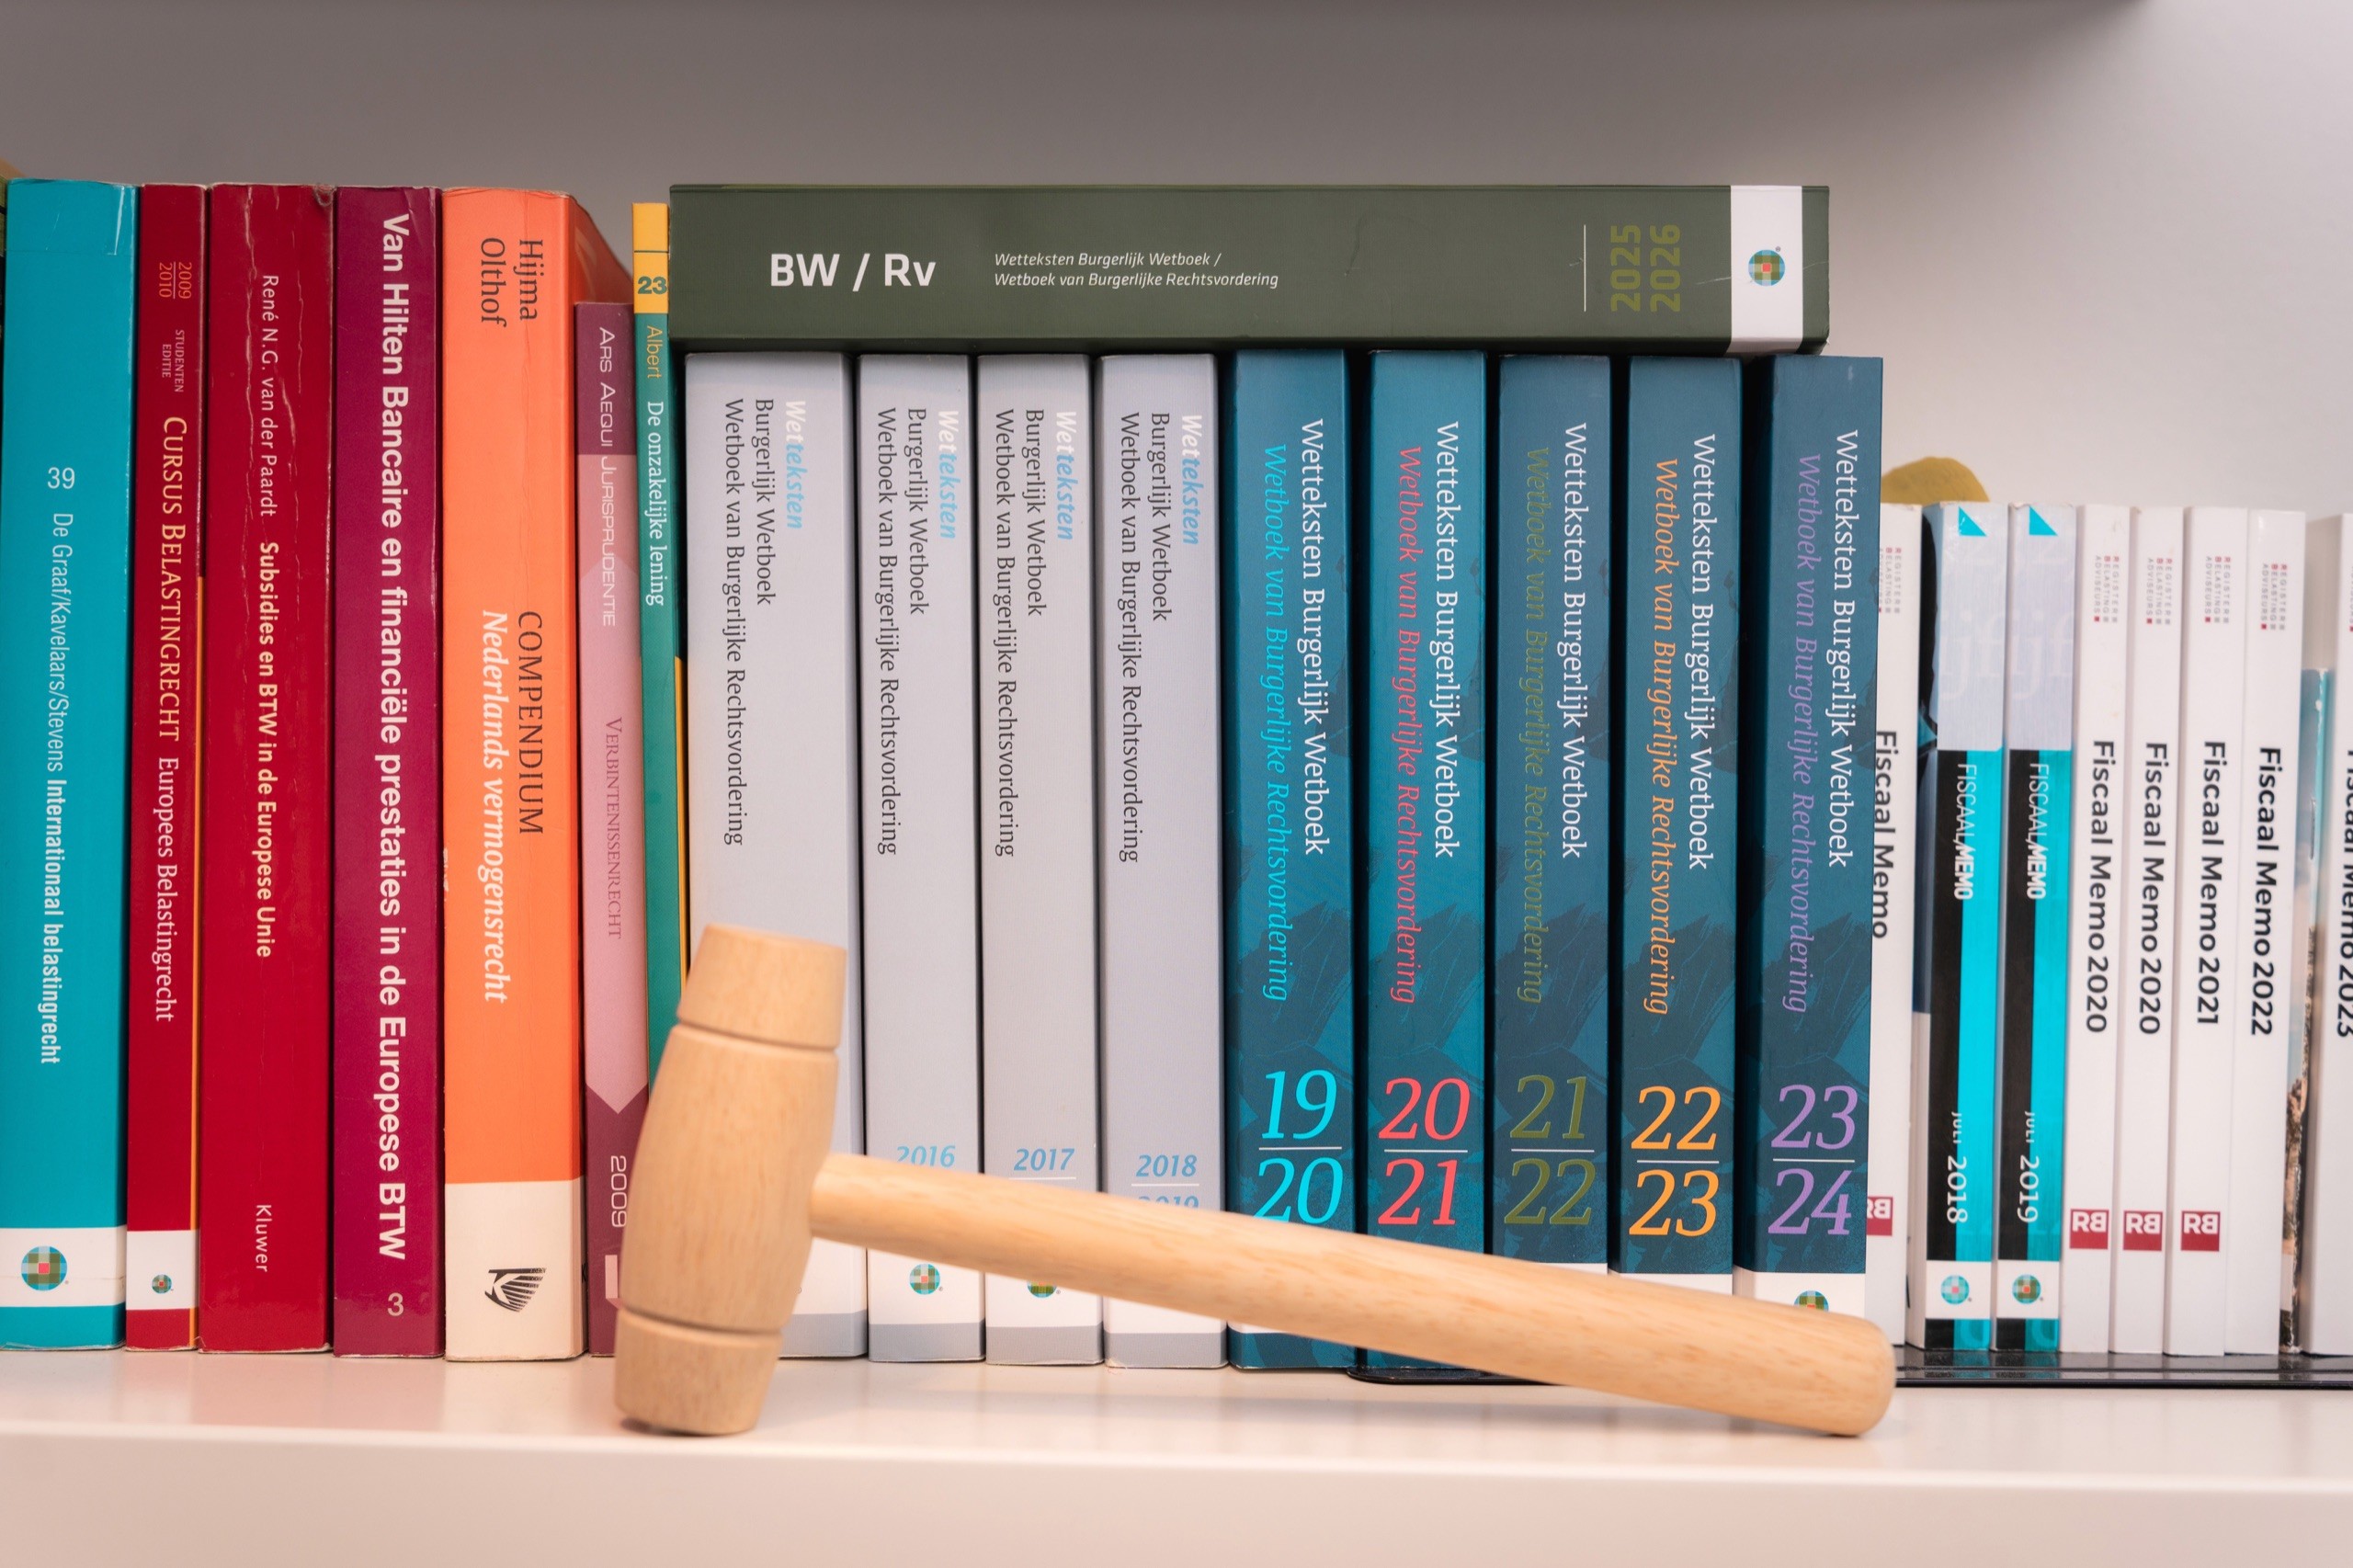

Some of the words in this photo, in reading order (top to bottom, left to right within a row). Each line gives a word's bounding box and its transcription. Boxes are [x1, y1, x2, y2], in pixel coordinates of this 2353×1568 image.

[159, 262, 173, 298] 2010
[178, 262, 191, 299] 2009
[383, 214, 410, 272] Van
[481, 238, 506, 327] Olthof
[513, 240, 543, 321] Hijma
[638, 277, 667, 295] 23
[770, 253, 840, 287] BW
[884, 254, 936, 286] Rv
[995, 253, 1074, 267] Wetteksten
[1078, 253, 1144, 270] Burgerlijk
[1149, 253, 1211, 267] Wetboek
[995, 273, 1055, 287] Wetboek
[1059, 276, 1086, 286] van
[1088, 273, 1162, 290] Burgerlijke
[1165, 273, 1279, 290] Rechtsvordering
[1610, 224, 1642, 312] 2025
[1650, 224, 1680, 312] 2026
[263, 276, 278, 321] René
[382, 283, 410, 374] Hilten
[163, 344, 171, 378] EDITIE
[175, 330, 184, 392] STUDENTEN
[261, 328, 278, 369] N.G.
[261, 377, 273, 411] van
[599, 327, 615, 373] ARS
[647, 325, 663, 379] Albert
[261, 417, 278, 449] der
[381, 387, 409, 528] Bancaire
[600, 382, 616, 447] AEQUI
[647, 402, 664, 426] De
[724, 399, 745, 494] Wetboek
[751, 399, 776, 502] Burgerlijk
[877, 408, 899, 504] Wetboek
[995, 409, 1017, 505] Wetboek
[1022, 408, 1046, 513] Burgerlijk
[1120, 412, 1142, 509] Wetboek
[48, 468, 74, 489] 39
[164, 417, 187, 514] CURSUS
[260, 455, 278, 517] Paardt
[644, 431, 667, 540] onzakelijke
[786, 401, 807, 529] Wetteksten
[938, 410, 961, 540] Wetteksten
[1056, 411, 1077, 540] Wetteksten
[1147, 412, 1171, 517] Burgerlijk
[1181, 415, 1205, 545] Wetteksten
[1264, 444, 1287, 562] Wetboek
[1301, 418, 1324, 578] Wetteksten
[1399, 447, 1422, 562] Wetboek
[1436, 421, 1460, 582] Wetteksten
[1564, 422, 1589, 582] Wetteksten
[1835, 430, 1859, 590] Wetteksten
[53, 514, 73, 537] De
[381, 539, 402, 576] en
[601, 456, 616, 626] JURISPRUDENTIE
[726, 501, 741, 539] van
[756, 510, 776, 606] Wetboek
[879, 511, 893, 548] van
[996, 512, 1011, 549] van
[1121, 517, 1136, 553] van
[1654, 459, 1679, 575] Wetboek
[1691, 434, 1716, 593] Wetteksten
[259, 543, 279, 644] Subsidies
[645, 545, 667, 607] lening
[722, 546, 745, 663] Burgerlijke
[875, 554, 899, 672] Burgerlijke
[908, 519, 930, 616] Wetboek
[994, 556, 1017, 674] Burgerlijke
[1026, 520, 1048, 617] Wetboek
[1151, 525, 1172, 622] Wetboek
[1266, 571, 1285, 617] van
[1399, 573, 1419, 619] van
[1654, 585, 1674, 631] van
[48, 546, 73, 771] Graaf/Kavelaars/Stevens
[159, 525, 186, 741] BELASTINGRECHT
[259, 652, 274, 676] en
[381, 586, 408, 744] financiële
[1118, 561, 1142, 678] Burgerlijke
[1298, 588, 1330, 724] Burgerlijk
[1430, 591, 1461, 727] Burgerlijk
[1558, 593, 1589, 727] Burgerlijk
[258, 684, 278, 736] BTW
[483, 610, 509, 769] Nederlands
[1260, 627, 1291, 773] Burgerlijke
[1392, 629, 1422, 774] Burgerlijke
[1647, 641, 1677, 788] Burgerlijke
[1686, 604, 1714, 739] Burgerlijk
[1827, 601, 1858, 736] Burgerlijk
[258, 744, 278, 762] in
[518, 611, 543, 835] COMPENDIUM
[724, 669, 747, 846] Rechtsvordering
[878, 678, 902, 856] Rechtsvordering
[995, 680, 1018, 857] Rechtsvordering
[153, 758, 178, 857] Europees
[257, 768, 278, 794] de
[1120, 686, 1143, 862] Rechtsvordering
[1303, 733, 1331, 855] Wetboek
[1434, 736, 1461, 858] Wetboek
[1561, 736, 1587, 858] Wetboek
[1687, 747, 1714, 869] Wetboek
[1828, 745, 1855, 868] Wetboek
[1874, 731, 1896, 833] Fiscaal
[2091, 741, 2115, 845] Fiscaal
[2143, 743, 2167, 846] Fiscaal
[2201, 741, 2225, 845] Fiscaal
[2257, 747, 2281, 851] Fiscaal
[44, 779, 66, 915] Internationaal
[252, 801, 277, 900] Europese
[374, 754, 406, 916] prestaties
[606, 717, 622, 939] VERBINTENISSENRECHT
[256, 907, 276, 957] Unie
[477, 778, 511, 1003] vermogensrecht
[1262, 781, 1293, 1002] Rechtsvordering
[1392, 784, 1422, 1005] Rechtsvordering
[1643, 796, 1676, 1015] Rechtsvordering
[1872, 845, 1894, 938] Memo
[2088, 856, 2111, 950] Memo
[2141, 858, 2165, 952] Memo
[2199, 856, 2222, 950] Memo
[2254, 862, 2278, 956] Memo
[152, 865, 177, 1021] Belastingrecht
[380, 969, 406, 1006] de
[381, 927, 406, 955] in
[38, 924, 63, 1063] belastingrecht
[2086, 956, 2109, 1032] 2020
[2139, 958, 2162, 1034] 2020
[2197, 958, 2220, 1024] 2021
[2251, 962, 2274, 1036] 2022
[373, 1017, 406, 1172] Europese
[1261, 1070, 1337, 1140] 19
[1379, 1077, 1471, 1141] 20
[1511, 1074, 1587, 1140] 21
[1631, 1085, 1722, 1150] 22
[1771, 1085, 1858, 1150] 23
[1951, 1112, 1962, 1143] JULI
[2025, 1111, 2035, 1143] JULI
[610, 1155, 627, 1228] 2009
[1013, 1148, 1075, 1172] 2017
[1136, 1154, 1198, 1177] 2018
[1253, 1157, 1343, 1225] 20
[1379, 1160, 1458, 1225] 21
[1505, 1159, 1597, 1225] 22
[1629, 1169, 1720, 1236] 23
[1768, 1168, 1851, 1235] 24
[1947, 1156, 1968, 1223] 2018
[2017, 1155, 2040, 1222] 2019
[256, 1204, 272, 1272] Kluwer
[380, 1183, 406, 1260] BTW
[388, 1293, 404, 1316] 3
